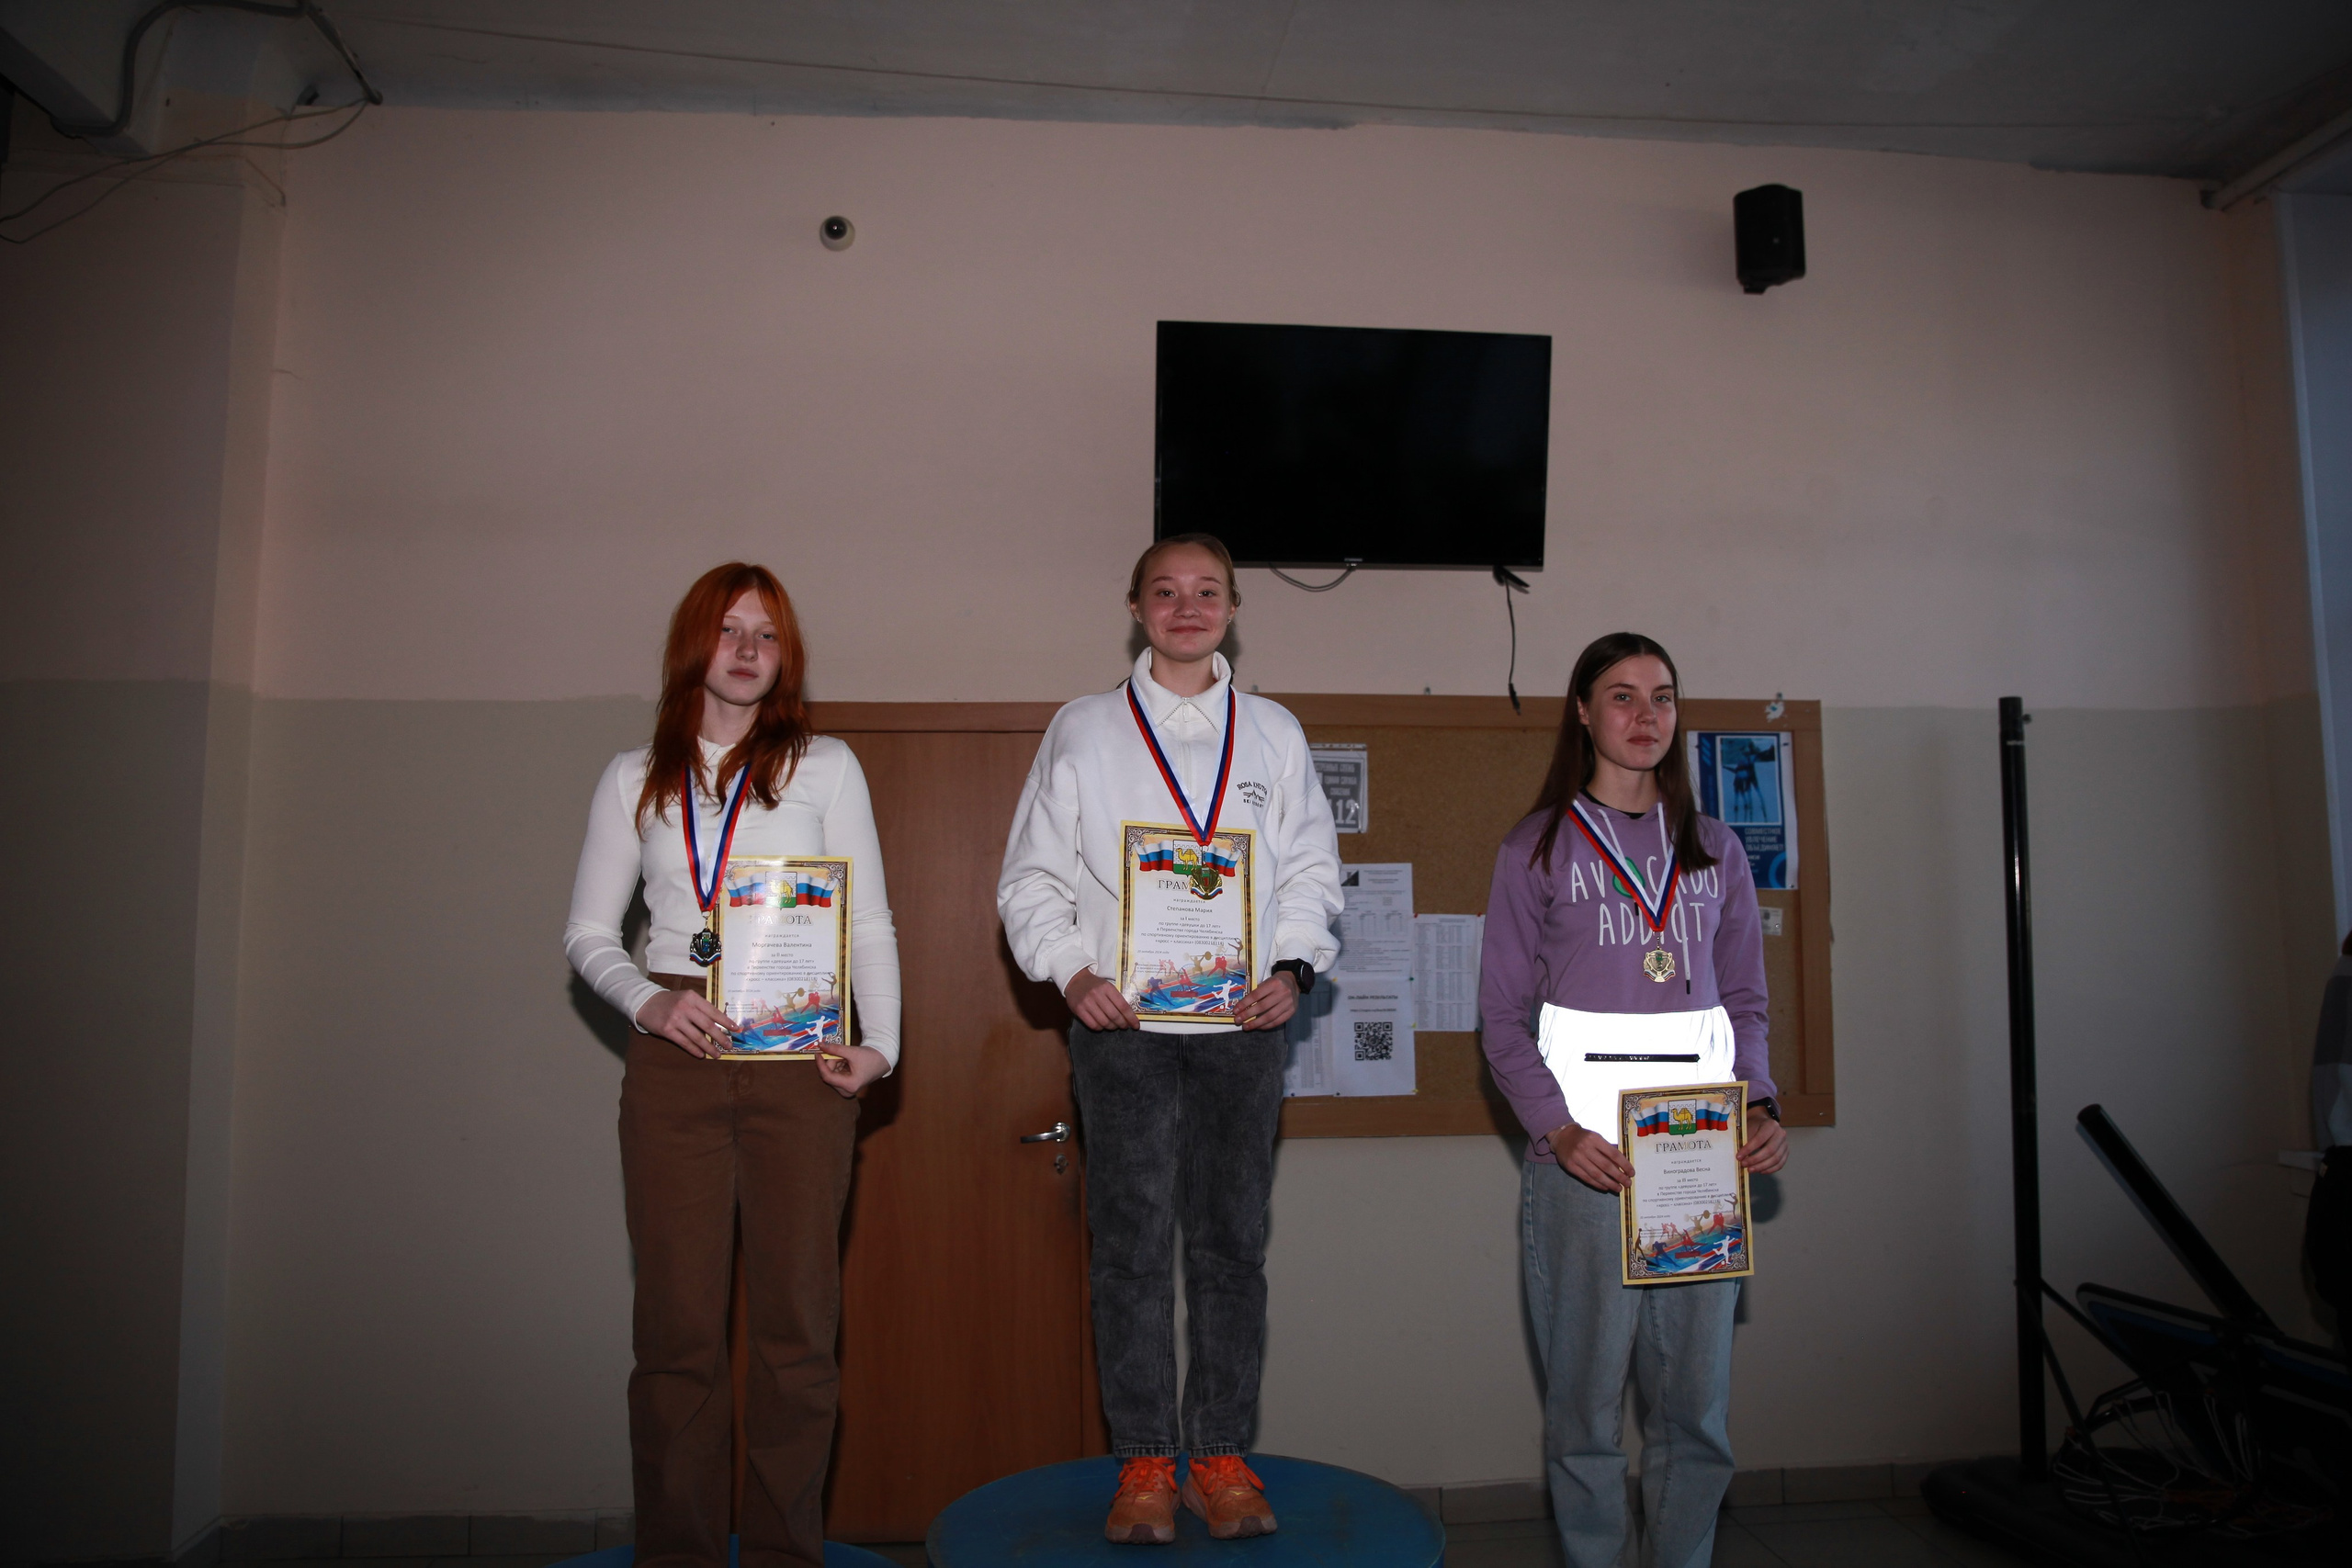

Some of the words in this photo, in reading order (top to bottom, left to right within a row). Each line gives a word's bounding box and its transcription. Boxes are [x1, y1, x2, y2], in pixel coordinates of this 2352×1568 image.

[1237, 781, 1252, 790] ROSA
[1158, 880, 1190, 890] ГРАМ
[1656, 1140, 1712, 1153] ГРАМОТА
